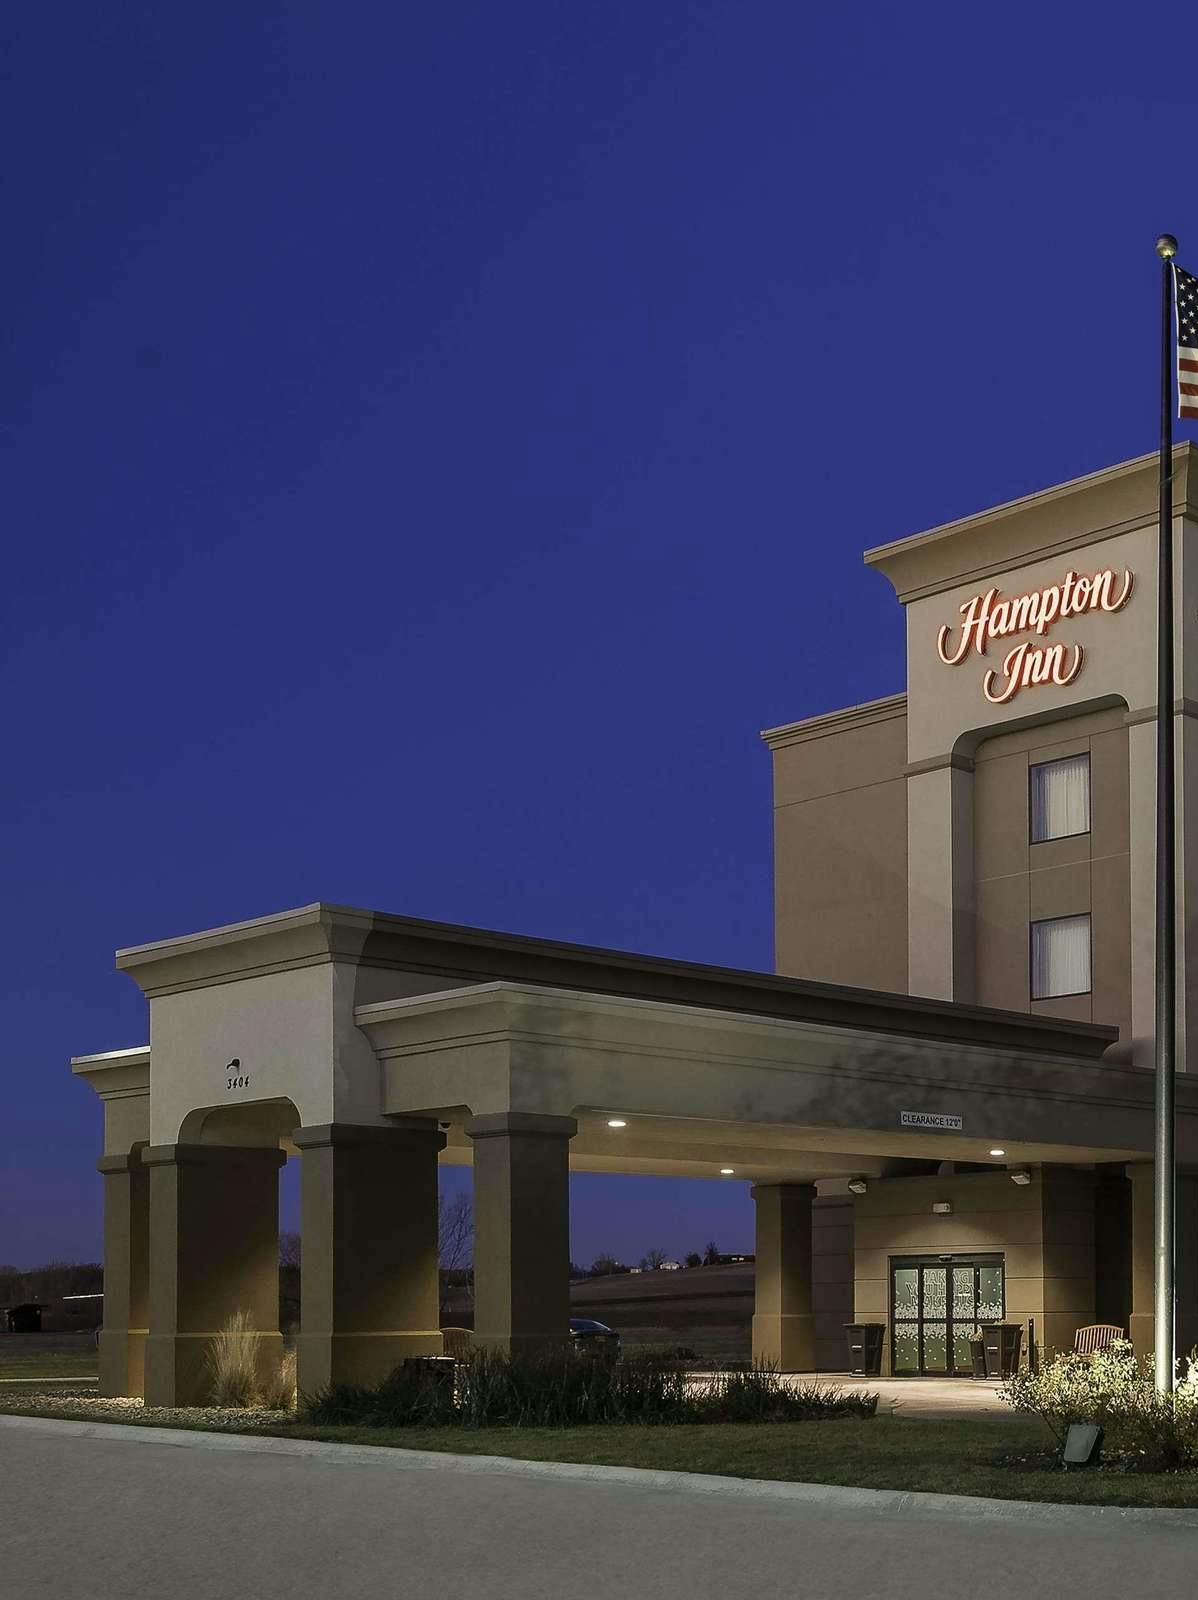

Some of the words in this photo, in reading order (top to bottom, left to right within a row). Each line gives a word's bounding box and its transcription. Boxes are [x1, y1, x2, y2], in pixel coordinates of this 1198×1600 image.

[937, 569, 1135, 665] Hampton
[983, 642, 1083, 703] Inn
[227, 1076, 249, 1089] 3404
[902, 1114, 945, 1126] CLEARANCE
[922, 1270, 969, 1284] AKNG
